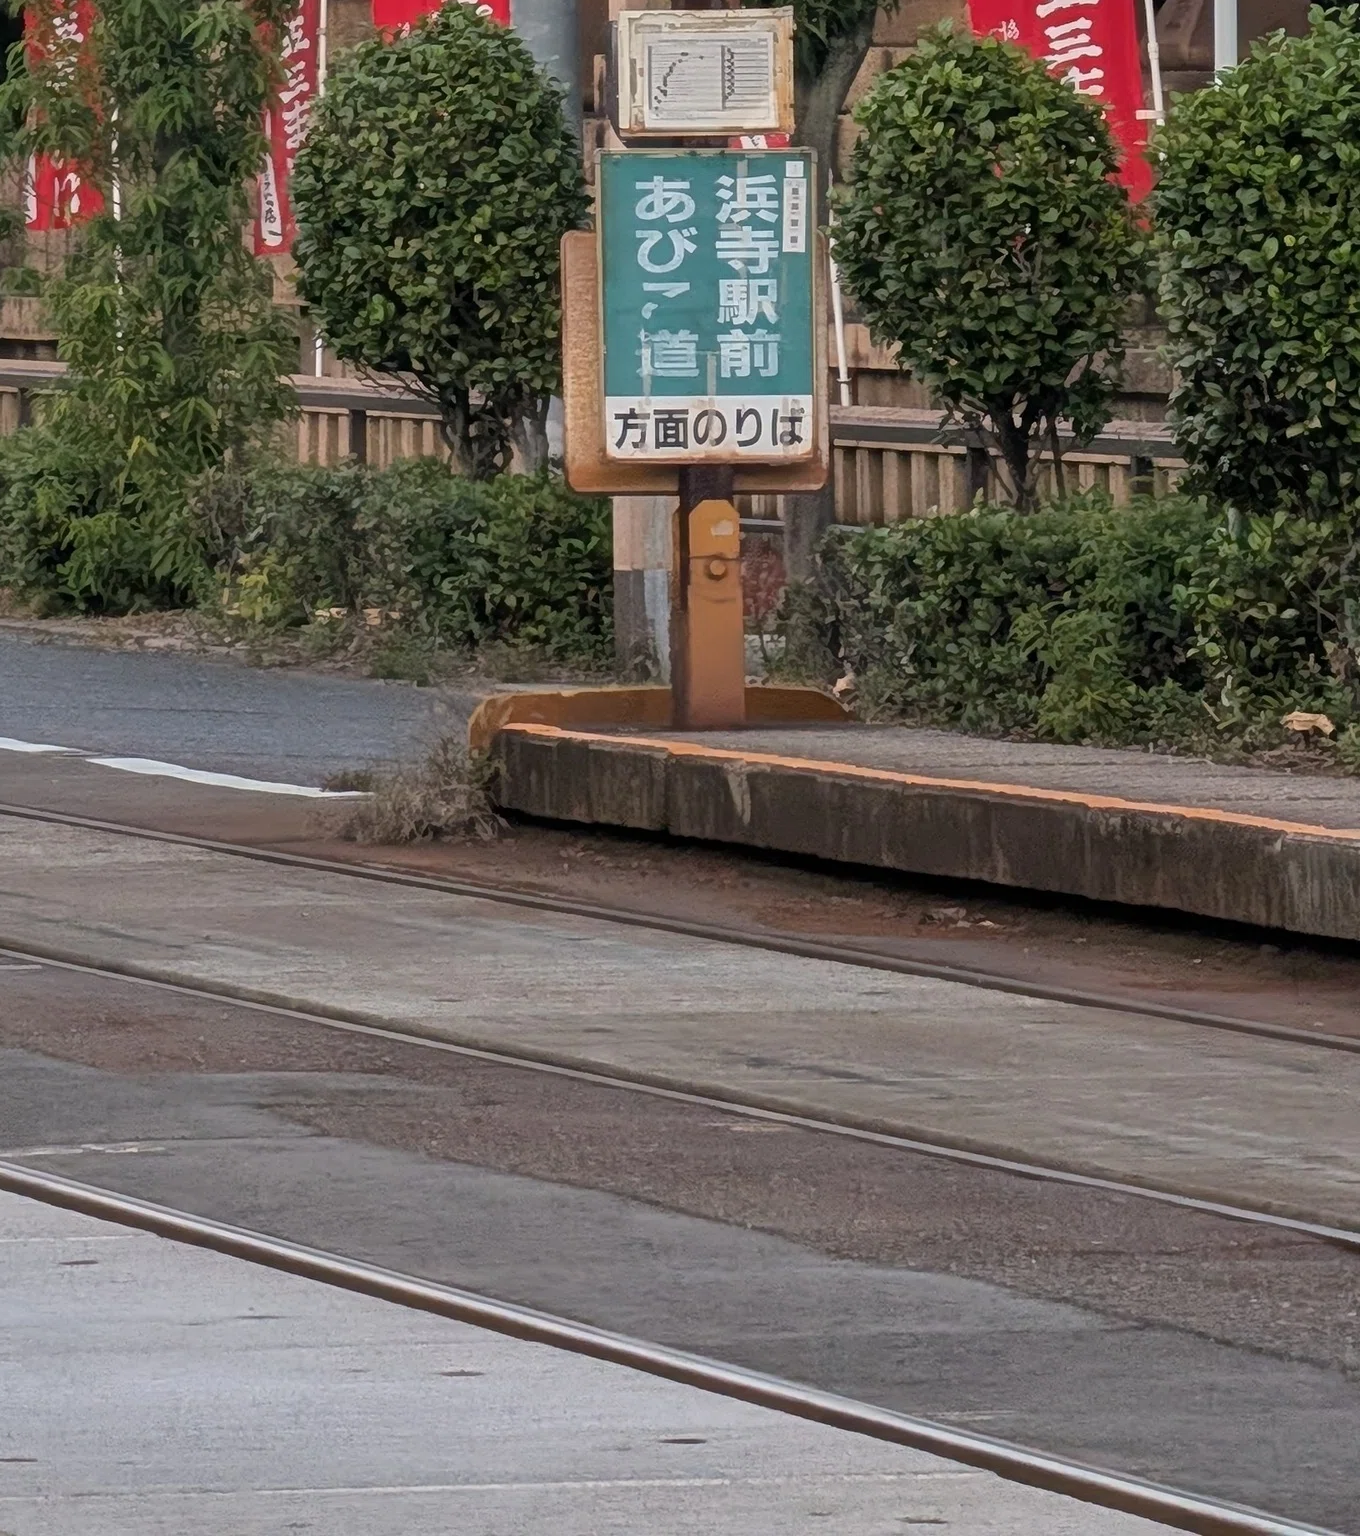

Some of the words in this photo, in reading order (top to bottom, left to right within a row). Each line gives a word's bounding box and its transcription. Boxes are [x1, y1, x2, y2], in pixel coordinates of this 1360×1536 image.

[634, 175, 700, 378] あびこ道
[715, 174, 781, 378] 浜寺駅前
[614, 406, 806, 451] 方面のりば
